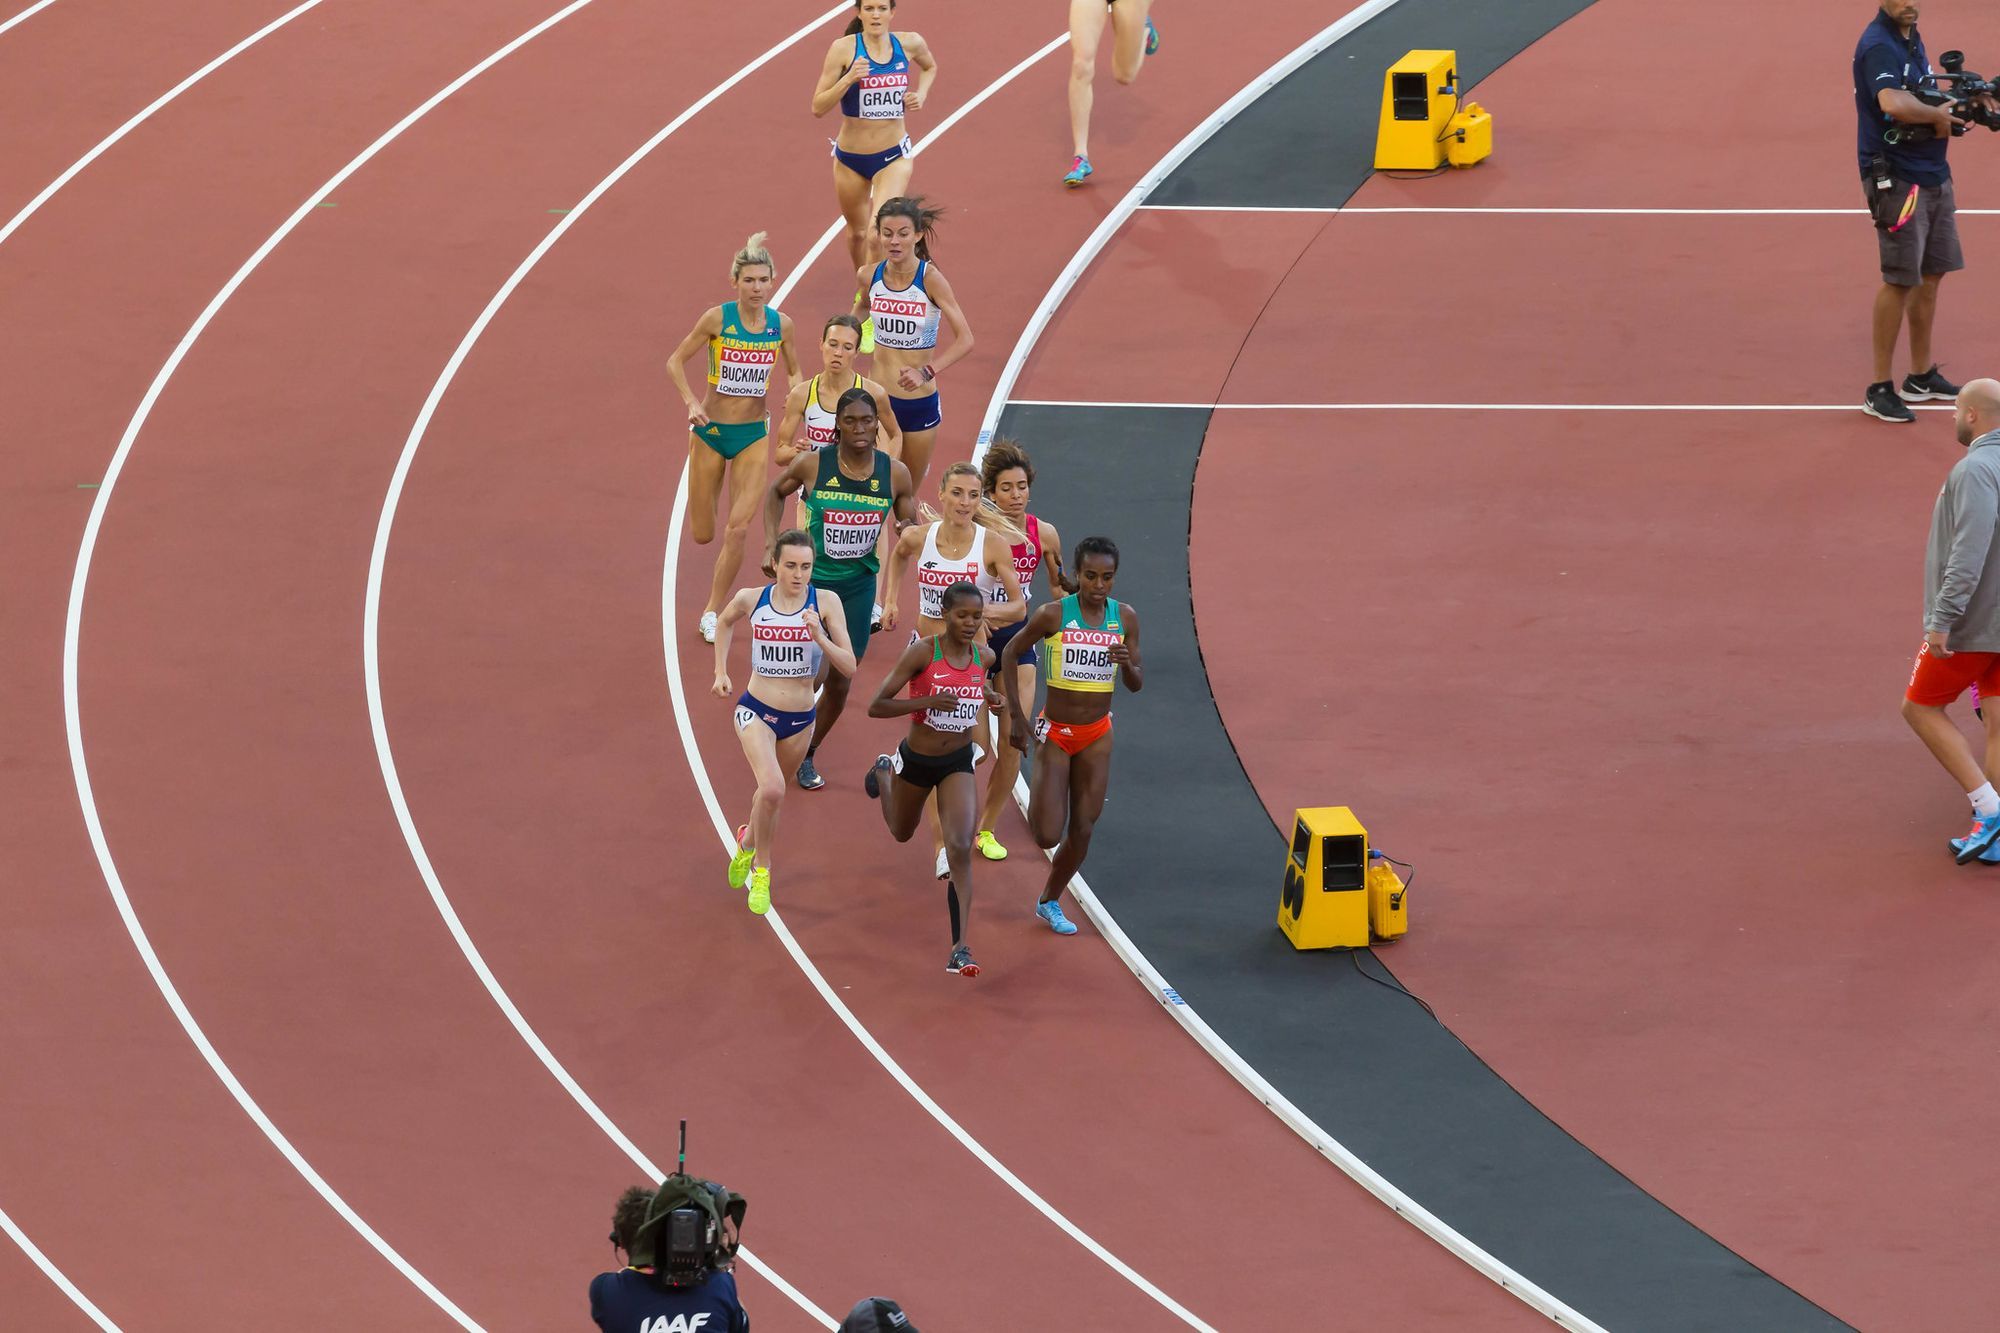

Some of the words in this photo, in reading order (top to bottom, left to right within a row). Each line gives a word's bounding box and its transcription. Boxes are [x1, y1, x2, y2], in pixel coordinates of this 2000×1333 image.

[861, 75, 908, 87] TOYOTA
[863, 90, 904, 106] GRAC
[874, 300, 924, 315] TOYOTA
[878, 317, 917, 335] JUDD
[877, 333, 904, 346] LONDON
[905, 337, 921, 346] 2017
[723, 349, 774, 363] TOYOTA
[719, 384, 752, 394] LONDON
[808, 427, 836, 441] TOY
[816, 490, 853, 502] SOUTH
[854, 493, 889, 507] AFRICA
[826, 511, 881, 524] TOYOTA
[825, 528, 876, 545] SEMENYA
[826, 547, 858, 557] LONDON
[920, 570, 973, 585] TOYOTA
[922, 587, 943, 604] CICH
[924, 606, 941, 617] LOND
[756, 627, 811, 640] TOYOTA
[1065, 631, 1119, 645] TOYOTA
[761, 645, 804, 662] MUIR
[757, 666, 790, 675] LONDON
[792, 667, 810, 675] 2017
[1063, 670, 1096, 680] LONDON
[640, 1312, 712, 1333] IAAF
